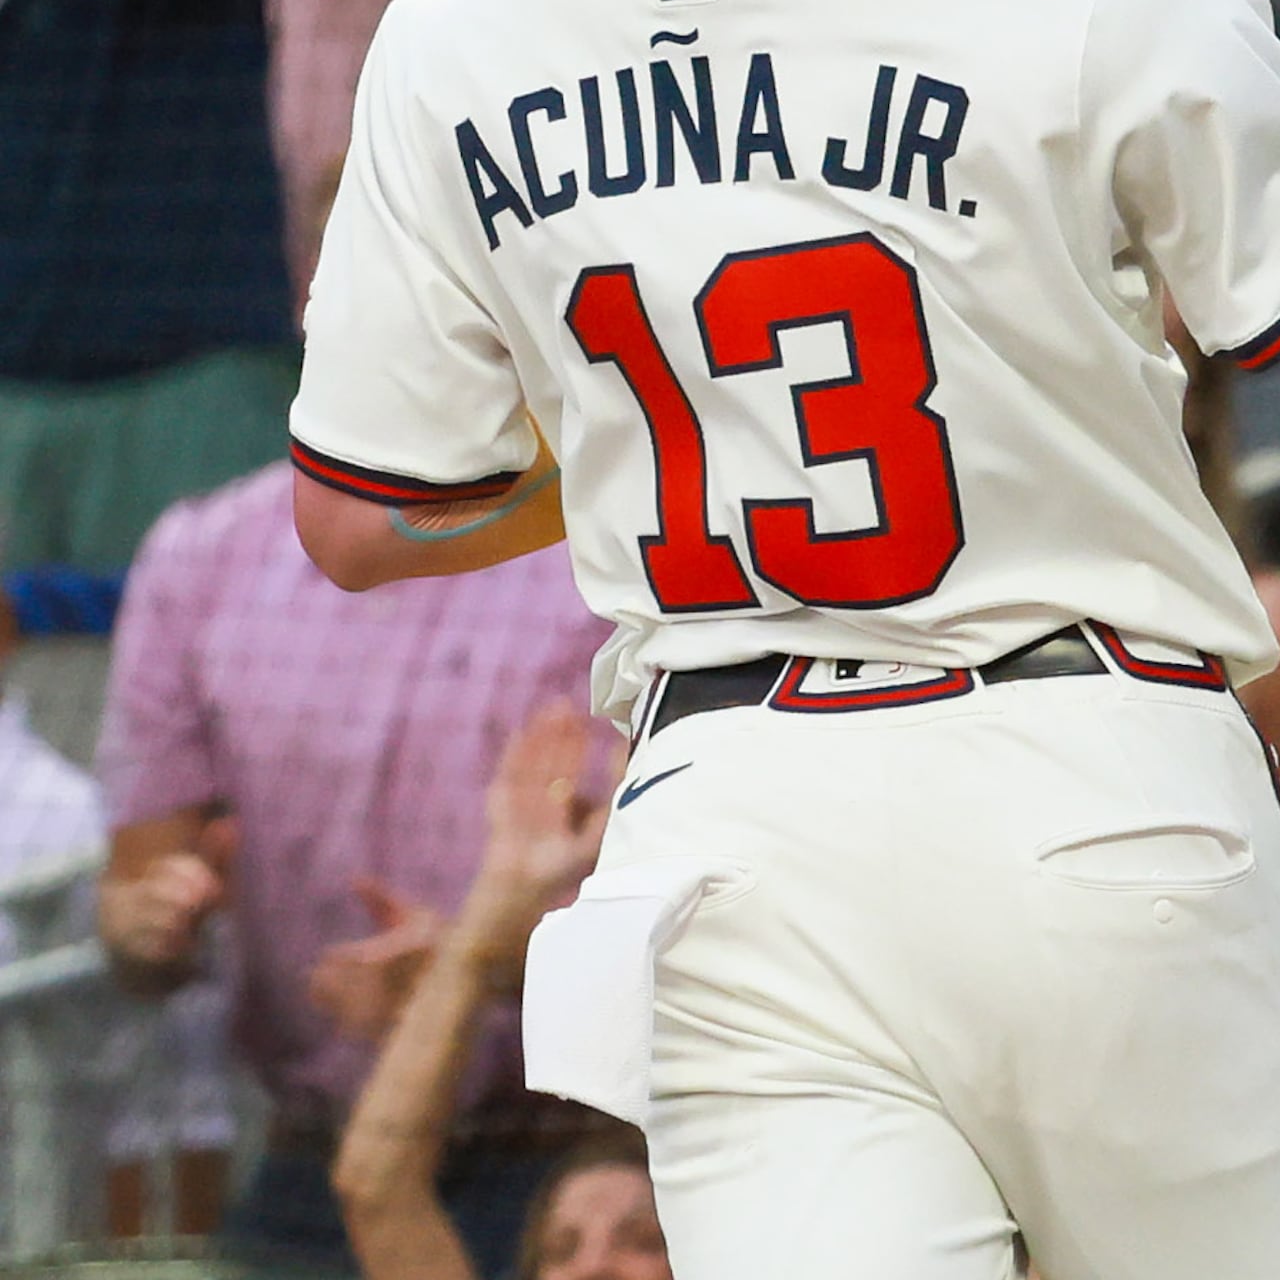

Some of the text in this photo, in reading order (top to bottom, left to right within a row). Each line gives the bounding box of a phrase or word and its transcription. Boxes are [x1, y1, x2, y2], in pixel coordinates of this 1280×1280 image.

[454, 26, 978, 253] ACUÑA JR.
[563, 230, 966, 613] 13
